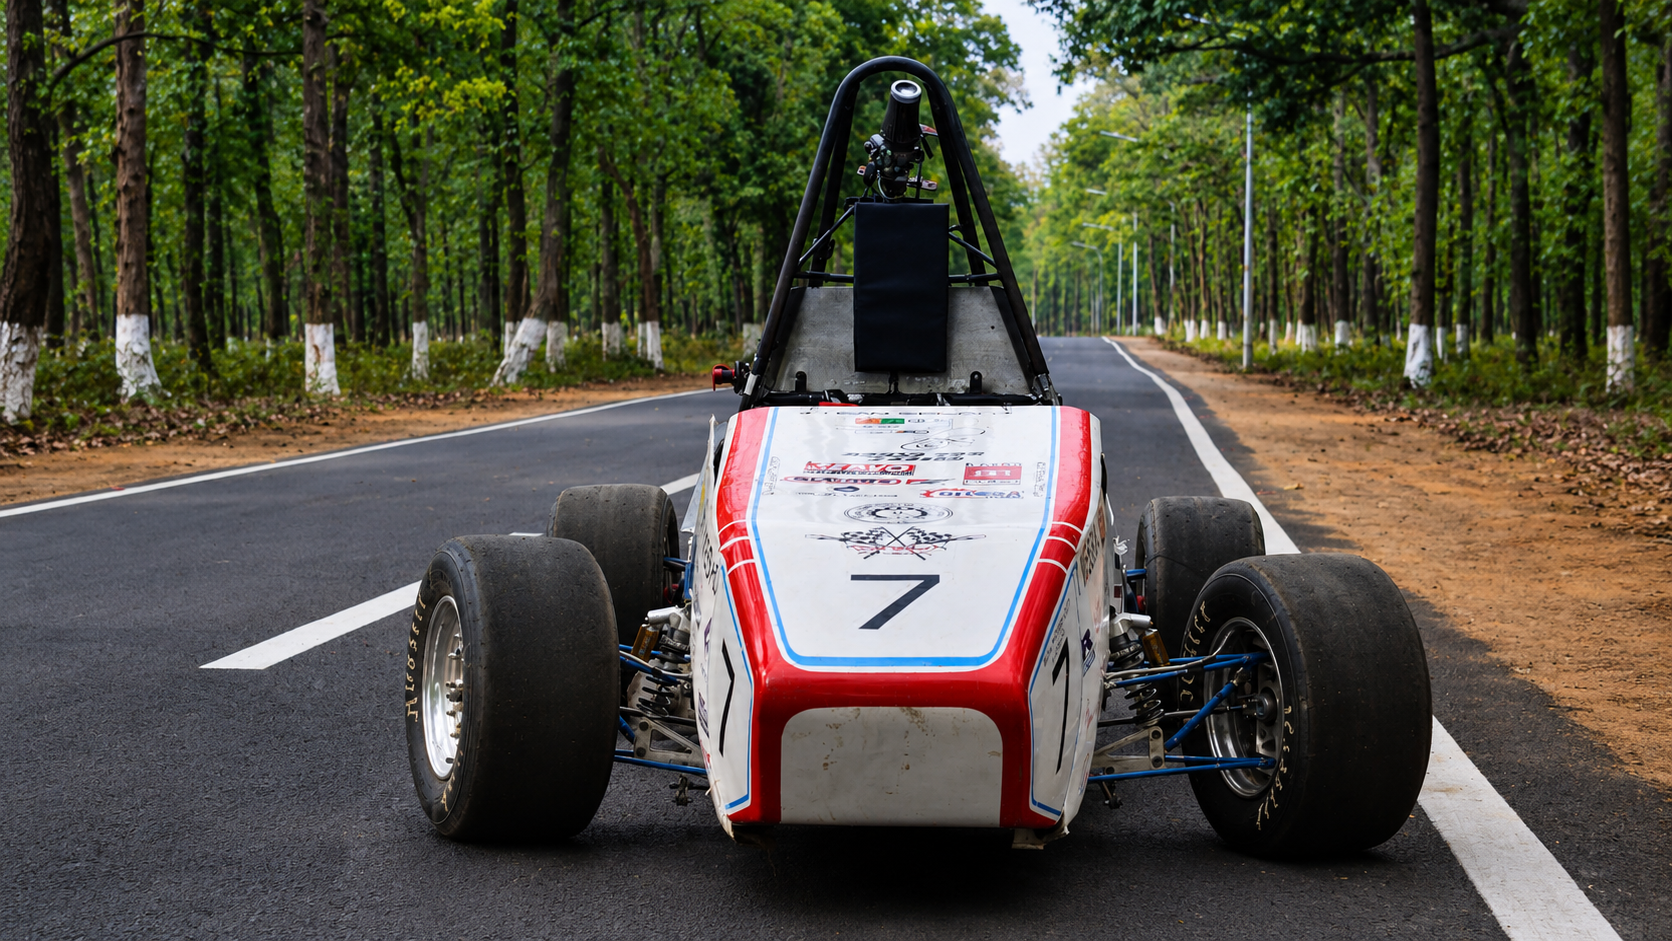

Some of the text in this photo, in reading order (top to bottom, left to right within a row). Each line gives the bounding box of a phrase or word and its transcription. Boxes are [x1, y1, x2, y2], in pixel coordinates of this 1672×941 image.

[850, 574, 940, 630] 7
[718, 638, 735, 757] 7
[1052, 637, 1070, 774] 7
